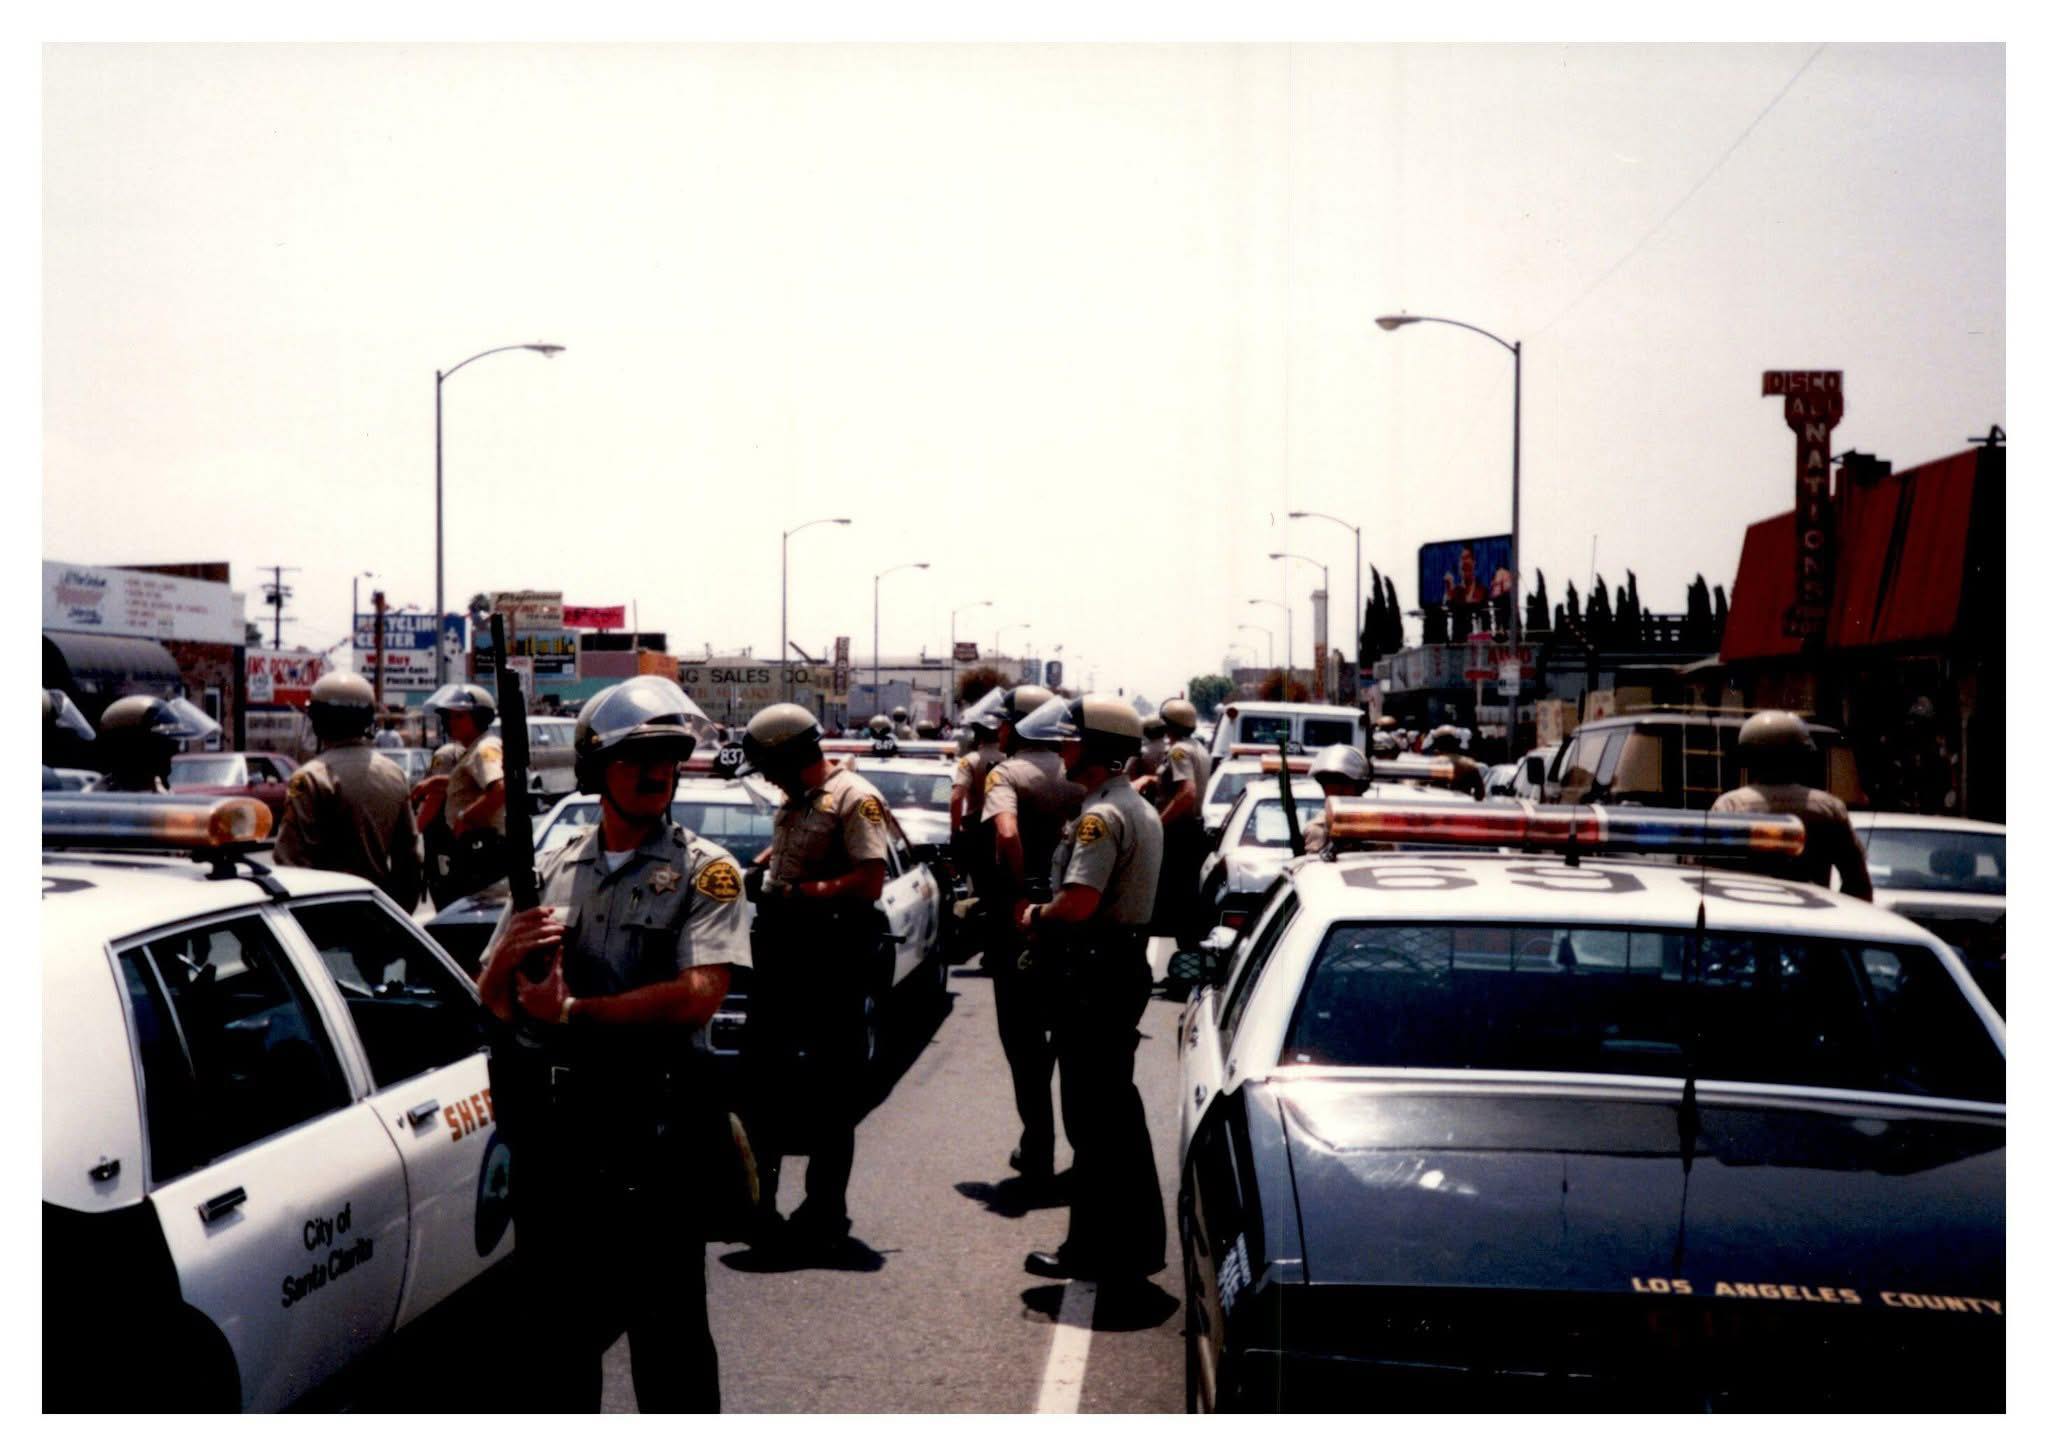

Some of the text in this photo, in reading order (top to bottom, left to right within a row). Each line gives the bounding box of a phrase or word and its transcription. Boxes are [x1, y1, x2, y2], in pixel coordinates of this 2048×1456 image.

[1764, 372, 1842, 394] DISCO
[356, 616, 438, 633] REYCLIN
[356, 632, 416, 648] CETER
[711, 669, 770, 683] SALES
[720, 747, 745, 766] 837
[303, 1202, 351, 1251] City of
[281, 1237, 373, 1308] Santa Clarita
[1631, 1277, 2002, 1315] LOS ANGELES COUNTY
